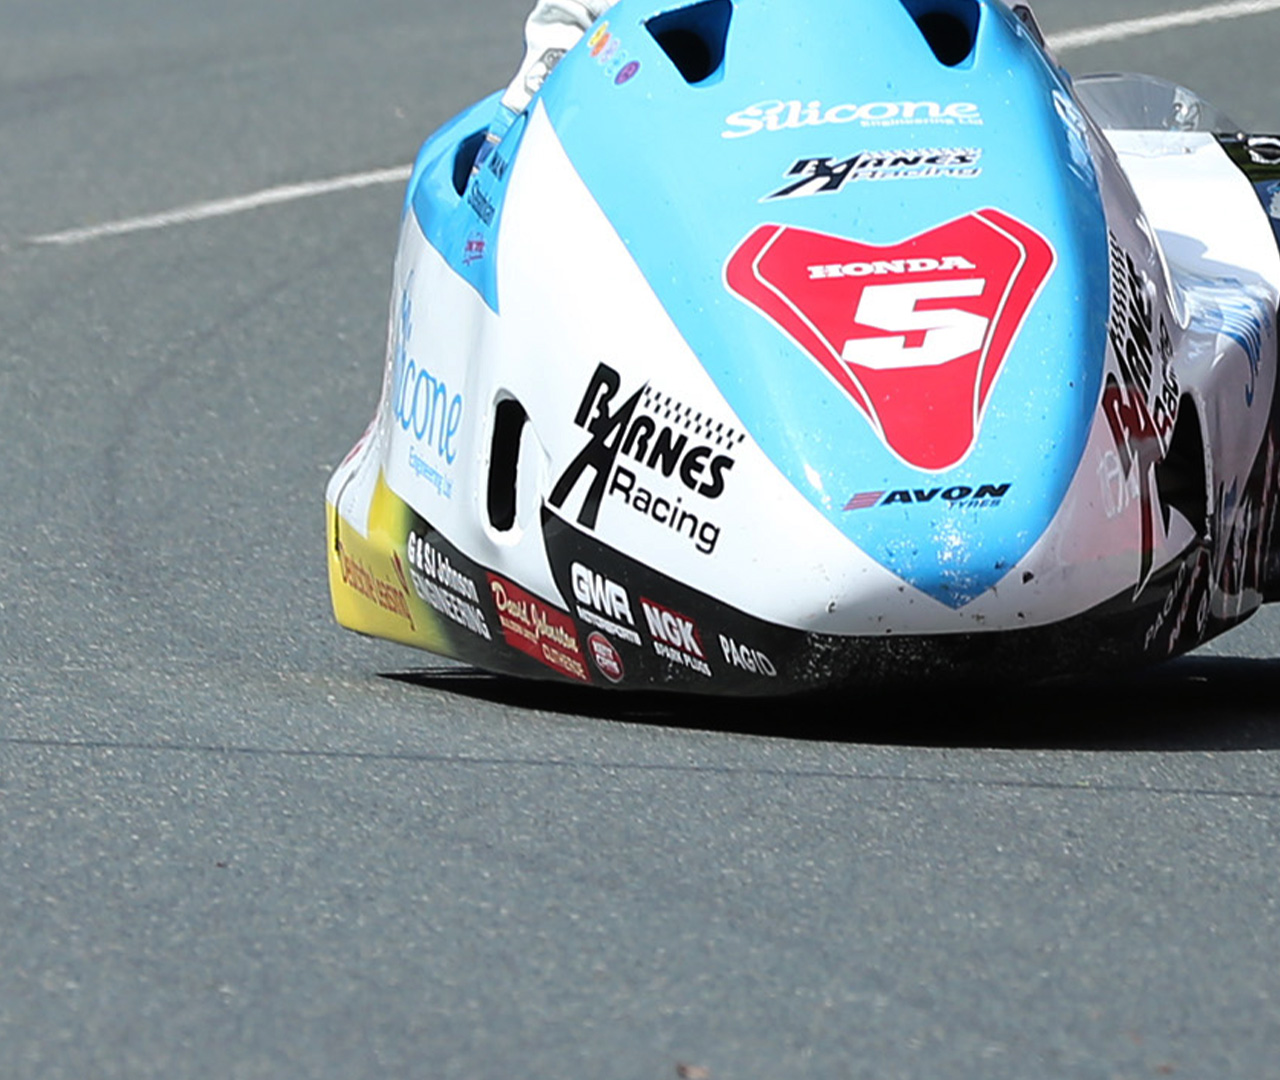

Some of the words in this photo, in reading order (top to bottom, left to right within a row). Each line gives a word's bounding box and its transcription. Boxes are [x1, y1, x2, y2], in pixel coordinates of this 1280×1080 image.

[721, 99, 981, 139] Silicone
[807, 256, 976, 280] HONDA
[841, 278, 989, 369] 5
[548, 361, 735, 531] BARNES
[608, 465, 721, 555] Racing
[880, 483, 1012, 507] AVON
[641, 602, 704, 658] NGK
[718, 634, 778, 677] PAGID
